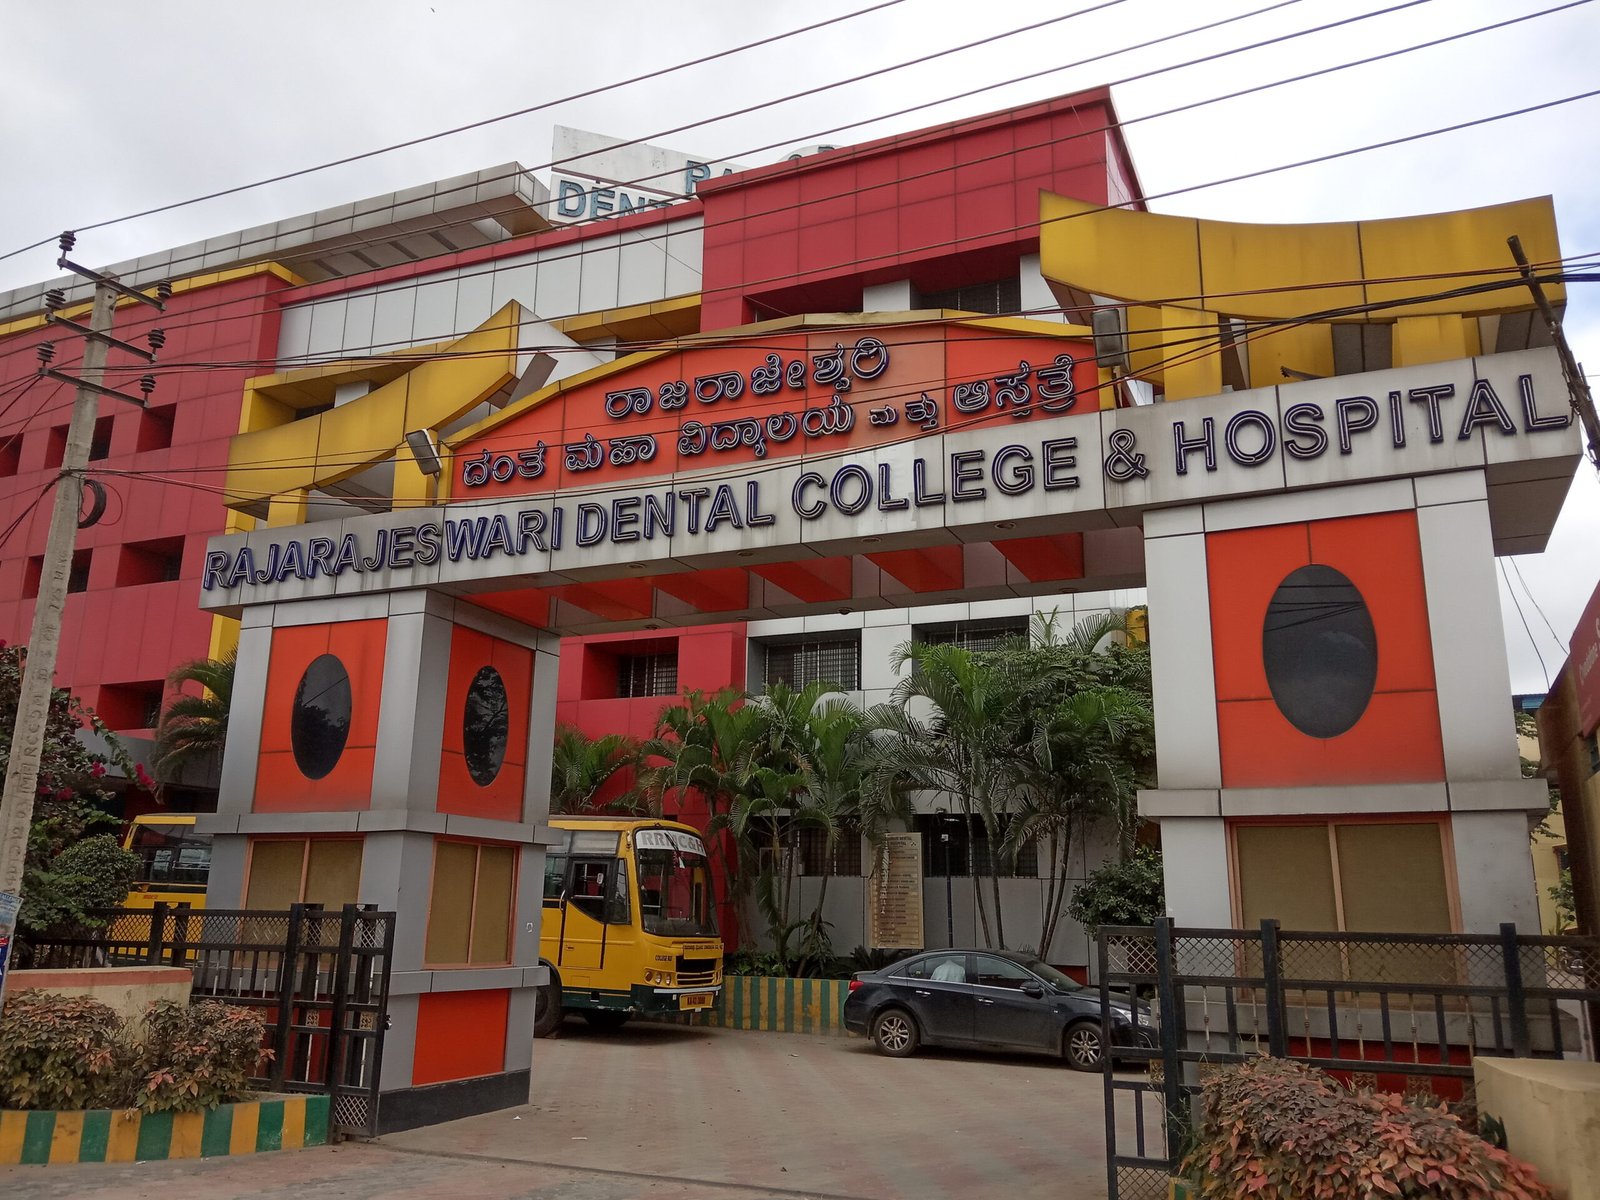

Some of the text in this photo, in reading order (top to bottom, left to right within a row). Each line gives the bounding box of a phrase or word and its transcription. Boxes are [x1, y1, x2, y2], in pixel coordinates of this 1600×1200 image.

[557, 179, 673, 220] DEN
[203, 374, 1569, 590] RAJARAJESWARI DENTAL COLLEGE & HOSPITAL
[462, 440, 547, 488] ದಂತ
